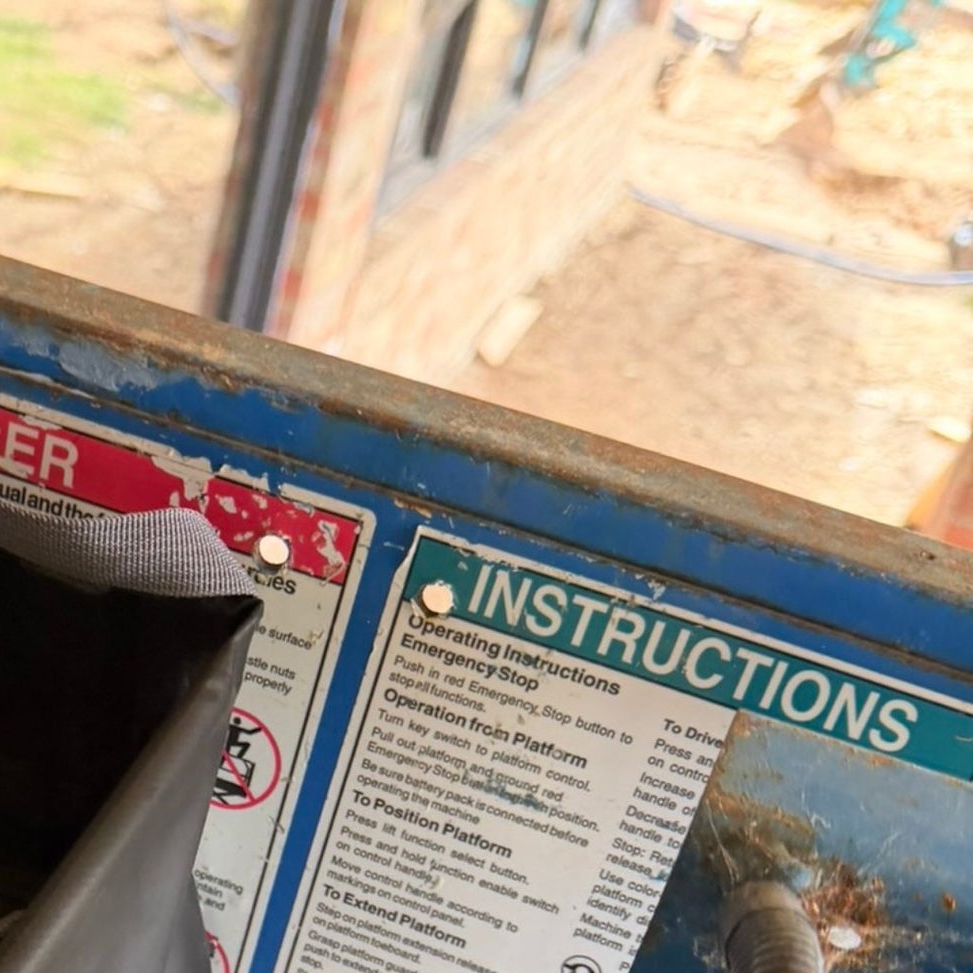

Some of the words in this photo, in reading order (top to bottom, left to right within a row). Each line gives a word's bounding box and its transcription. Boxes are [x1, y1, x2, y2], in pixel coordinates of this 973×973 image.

[27, 494, 63, 516] and
[269, 628, 312, 650] surface
[407, 613, 501, 659] Operating
[502, 644, 620, 695] Instructions
[467, 565, 919, 754] INSTRUCTIONS
[245, 671, 292, 696] properly
[247, 656, 268, 670] stle
[270, 662, 296, 679] nuts
[400, 632, 497, 679] Emergency
[497, 665, 539, 692] Stop
[388, 672, 415, 689] stop
[429, 683, 486, 712] functions.
[393, 654, 425, 675] Push
[427, 668, 440, 679] in
[443, 674, 465, 688] red
[467, 679, 538, 714] Emergency
[541, 704, 572, 725] Stop
[574, 716, 616, 739] button
[619, 732, 633, 745] to
[383, 687, 467, 727] Operation
[511, 731, 587, 768] Platform
[664, 718, 682, 734] To
[370, 725, 394, 742] Pull
[395, 737, 416, 751] out
[417, 745, 466, 770] platform
[468, 763, 494, 782] and
[541, 788, 564, 802] red
[378, 707, 404, 726] Turn
[407, 719, 430, 737] key
[433, 730, 471, 750] switch
[475, 743, 488, 756] to
[490, 750, 542, 774] platform
[545, 769, 590, 792] control.
[647, 755, 665, 768] on
[653, 737, 692, 760] Press
[695, 754, 713, 767] an
[356, 774, 410, 801] operating
[410, 791, 430, 807] the
[430, 800, 480, 825] machine
[361, 757, 377, 772] Be
[377, 766, 404, 782] sure
[404, 773, 445, 798] battery
[444, 790, 474, 807] pack
[474, 801, 486, 811] is
[485, 805, 550, 833] connected
[548, 825, 589, 847] before
[366, 740, 432, 774] Emergency
[431, 763, 460, 783] Stop
[547, 806, 599, 832] position.
[632, 786, 677, 810] handle
[639, 771, 695, 800] Increase
[352, 789, 371, 806] To
[372, 797, 439, 832] Position
[441, 822, 512, 858] Platform
[618, 819, 662, 843] handle
[625, 804, 686, 835] Decrease
[344, 808, 377, 829] Press
[382, 823, 396, 835] lift
[400, 829, 445, 853] function
[450, 849, 485, 868] select
[489, 862, 528, 885] button.
[611, 837, 646, 857] Stop:
[340, 825, 372, 845] Press
[375, 841, 398, 855] and
[400, 848, 427, 865] hold
[429, 858, 475, 883] function
[478, 879, 518, 899] enable
[521, 895, 559, 914] switch
[598, 868, 624, 886] Use
[323, 883, 341, 900] To
[342, 891, 398, 922] Extend
[398, 913, 466, 948] Platform
